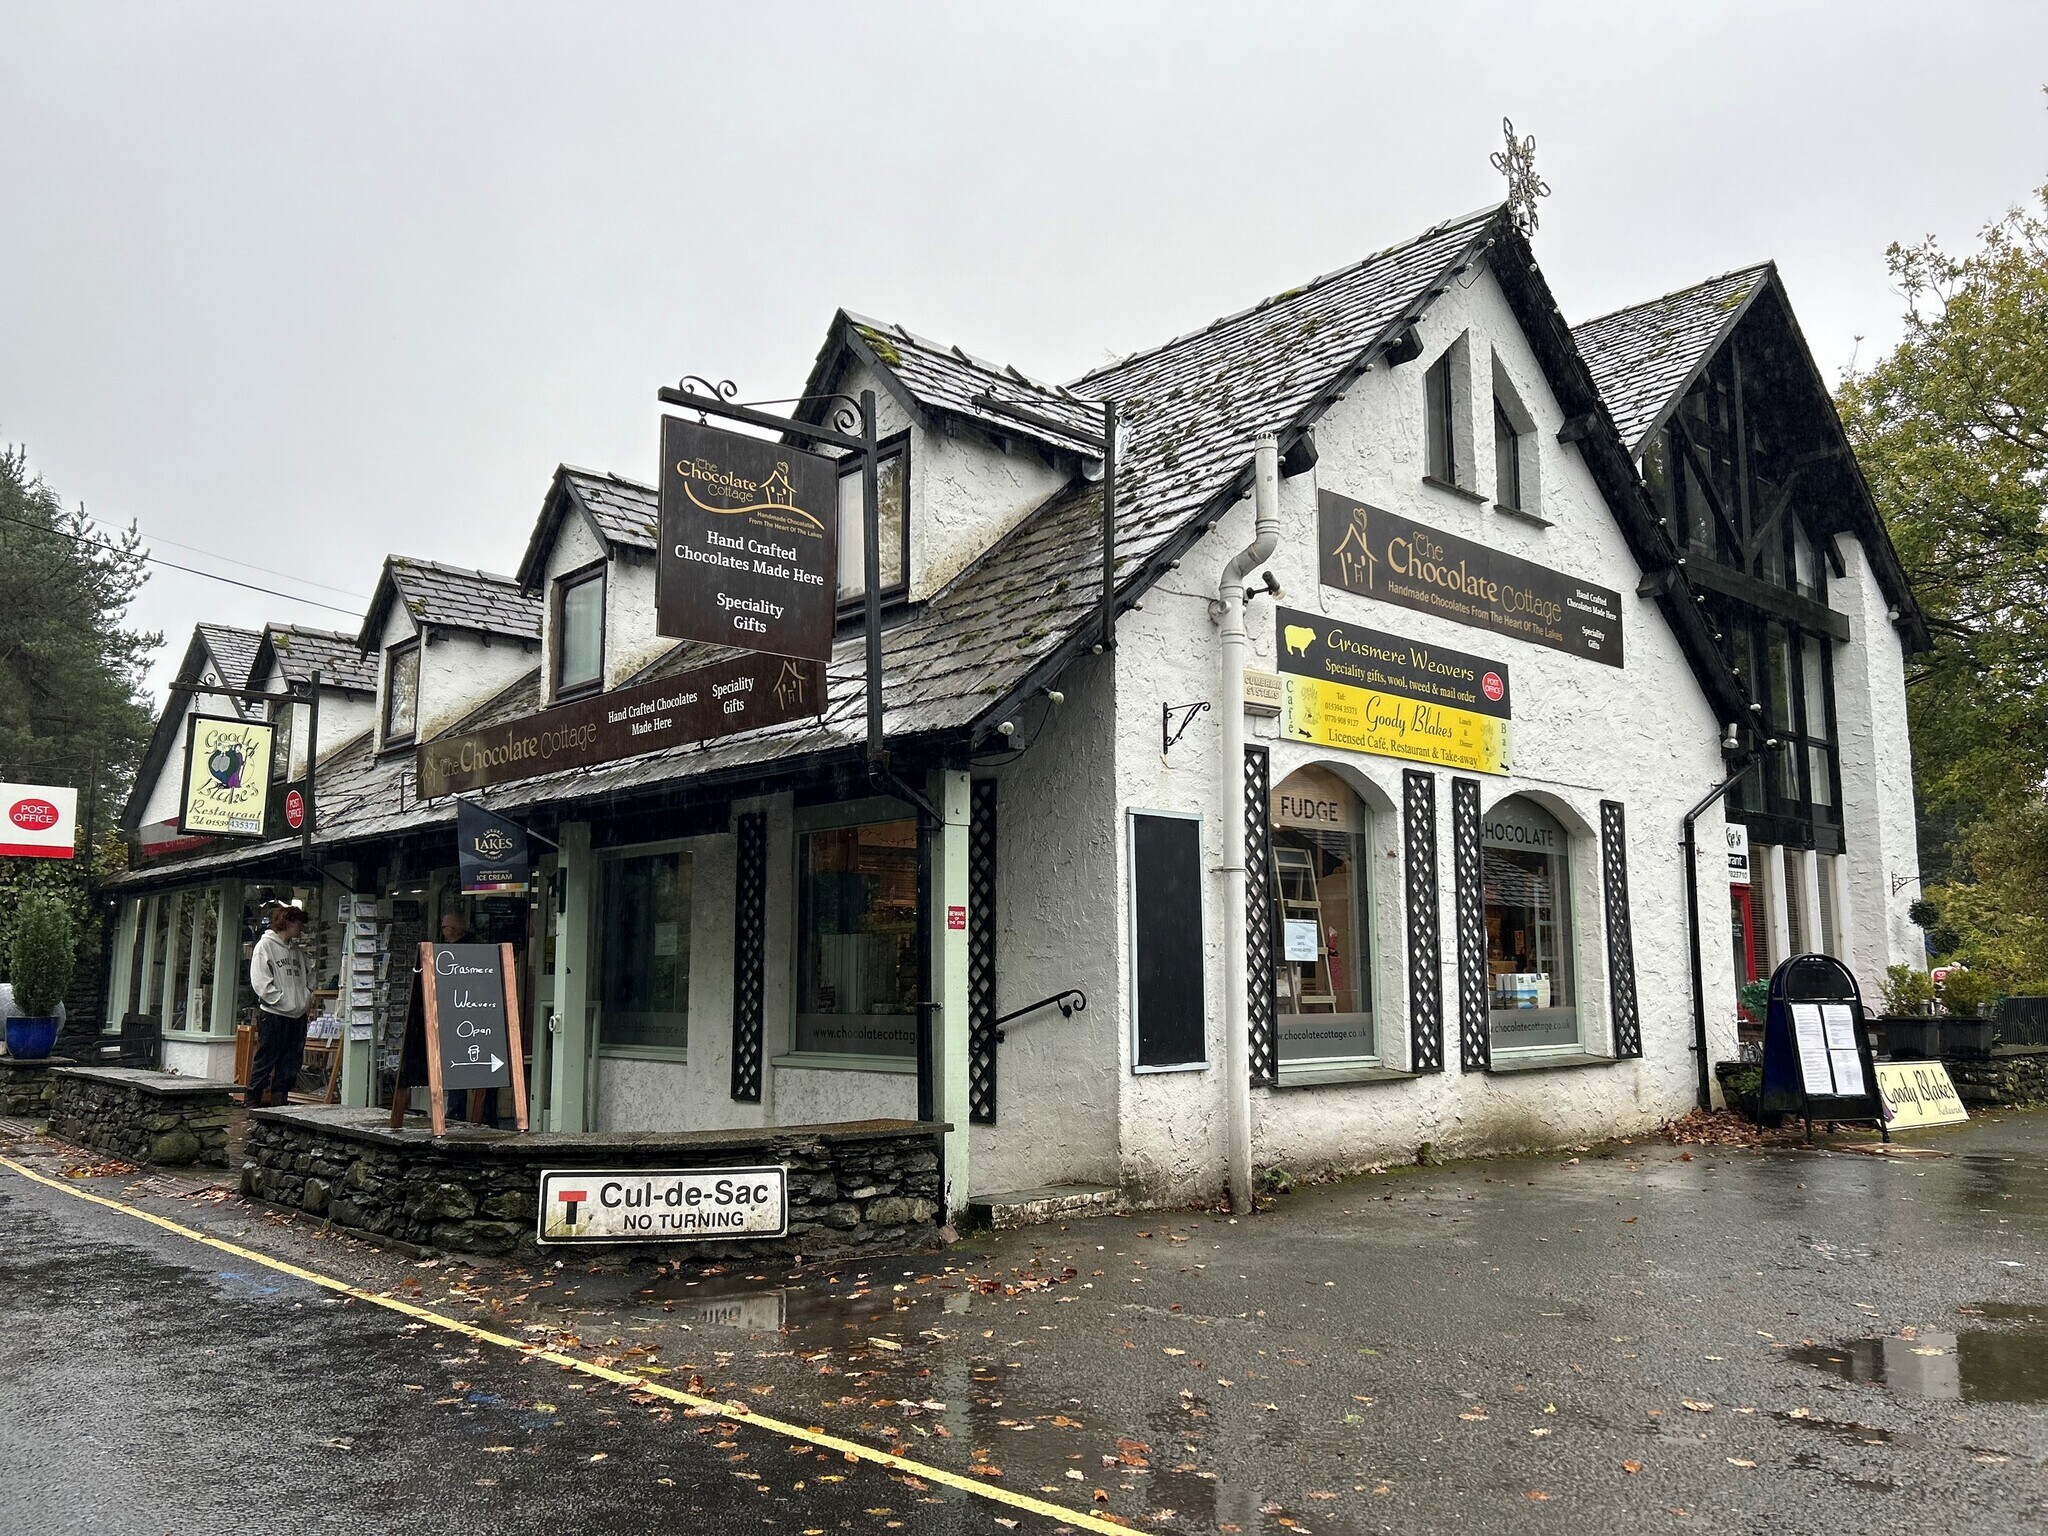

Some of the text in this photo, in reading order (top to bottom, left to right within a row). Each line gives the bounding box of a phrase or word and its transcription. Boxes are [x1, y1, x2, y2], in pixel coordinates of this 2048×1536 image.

[696, 458, 718, 473] The
[676, 459, 757, 493] Chocolate
[707, 484, 754, 503] Cottage
[748, 517, 763, 526] From
[764, 521, 774, 529] The
[775, 523, 789, 532] Heart
[797, 527, 807, 536] The
[808, 531, 823, 539] Lakes
[757, 511, 815, 530] Handmade Chocolates
[707, 530, 797, 562] Hand Crafted
[1413, 531, 1444, 562] The
[674, 544, 824, 586] Chocolates Made Here
[1387, 537, 1562, 626] Chocolate Cottage
[716, 592, 785, 620] Speciality
[1576, 589, 1607, 607] Hand Crafted
[1388, 580, 1564, 642] Handmade Chocolates From The Heart Of The Lakes
[1566, 597, 1618, 621] Chocolates Made Here
[733, 615, 767, 634] Gifts
[1581, 625, 1606, 642] Speciality
[1588, 639, 1600, 650] Gifts
[1327, 629, 1475, 682] Grasmere Weavers
[712, 676, 755, 699] Speciality
[1244, 674, 1282, 691] CUMBRIAN
[1325, 658, 1476, 704] Speciality gifts, wool, tweed & mail order
[1485, 685, 1501, 694] OFFICE
[1487, 677, 1499, 686] POST
[1246, 687, 1279, 700] SYSTEMS
[608, 692, 698, 724] Hand Crafted Chocolates
[723, 699, 745, 715] Gifts
[1366, 695, 1453, 739] Goody Blakes
[631, 717, 673, 736] Made Here
[204, 727, 260, 757] Goody
[439, 723, 597, 778] The Chocolate Cottage
[1328, 728, 1366, 747] Licensed
[1367, 735, 1388, 753] Café,
[1391, 739, 1431, 758] Restaurant
[1432, 747, 1439, 759] &
[1440, 748, 1479, 769] Take-away
[197, 778, 259, 805] Blake's
[21, 804, 50, 815] POST
[189, 799, 262, 820] Restaurant
[289, 798, 300, 809] POST
[289, 808, 302, 819] OFFICE
[1281, 795, 1338, 822] FUDGE
[13, 813, 53, 824] OFFICE
[229, 820, 258, 831] 435371
[1482, 821, 1554, 847] HOCOLATE
[474, 837, 513, 852] LAKES
[488, 873, 513, 881] CREAM
[436, 950, 494, 976] Grasmere
[454, 990, 497, 1009] Weavers
[456, 1020, 492, 1038] Open
[813, 1025, 917, 1045] www.chocolatecottag
[1880, 1069, 1955, 1116] Goody Blake's
[600, 1179, 769, 1209] Cul-de-Sac
[623, 1211, 744, 1231] NO TURNING
